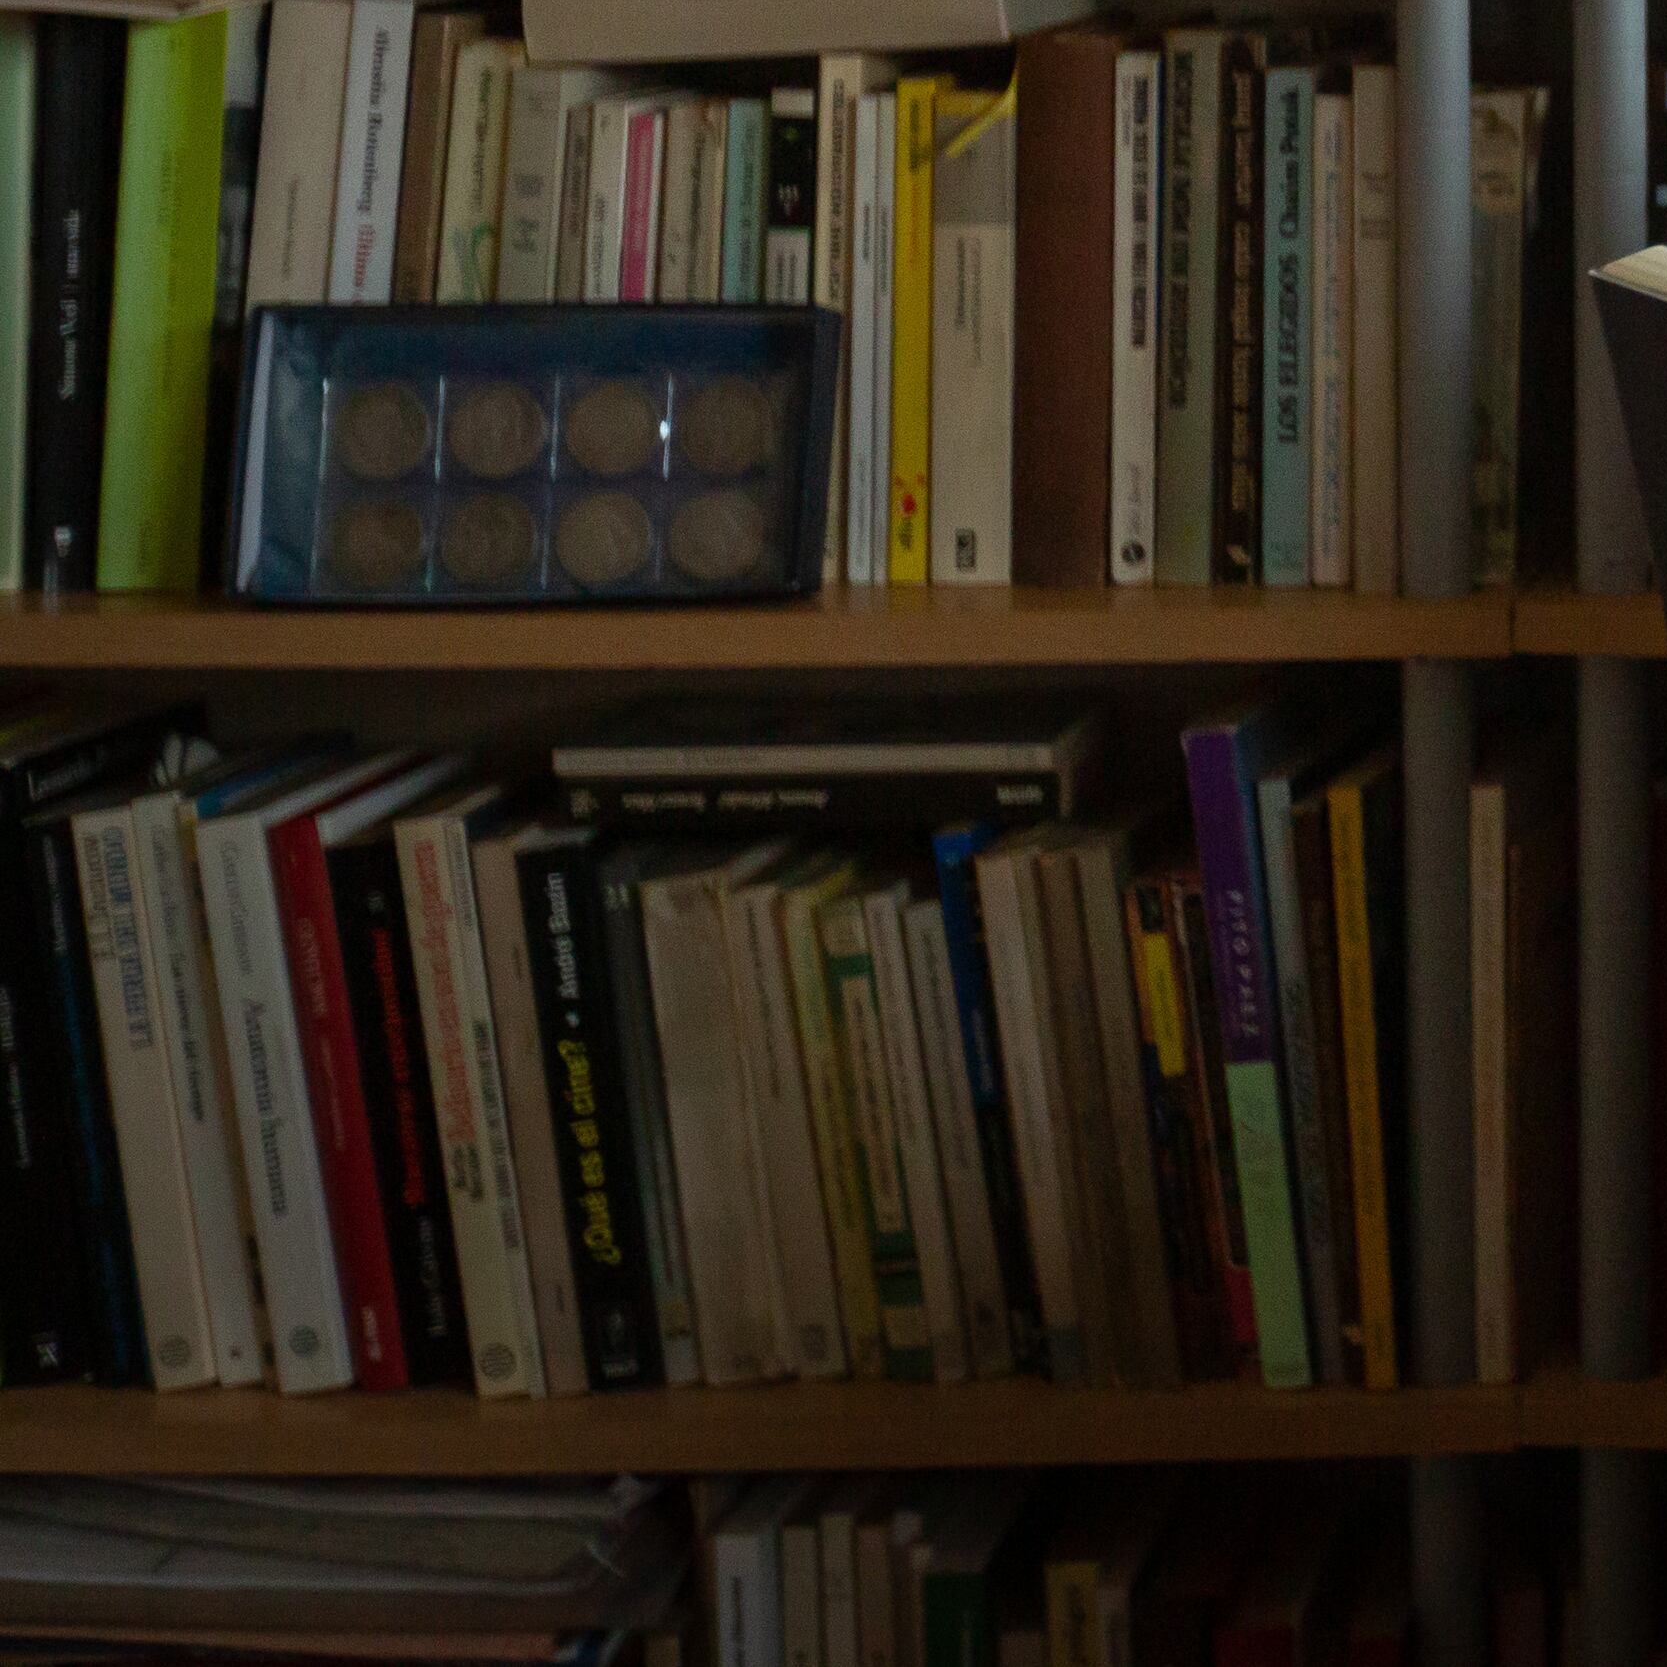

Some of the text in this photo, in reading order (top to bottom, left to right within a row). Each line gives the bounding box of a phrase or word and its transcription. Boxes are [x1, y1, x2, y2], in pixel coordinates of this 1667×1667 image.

[1278, 252, 1301, 387] ELEGIDOS
[1278, 395, 1301, 444] LOS
[576, 1120, 600, 1140] el
[582, 1148, 603, 1178] es
